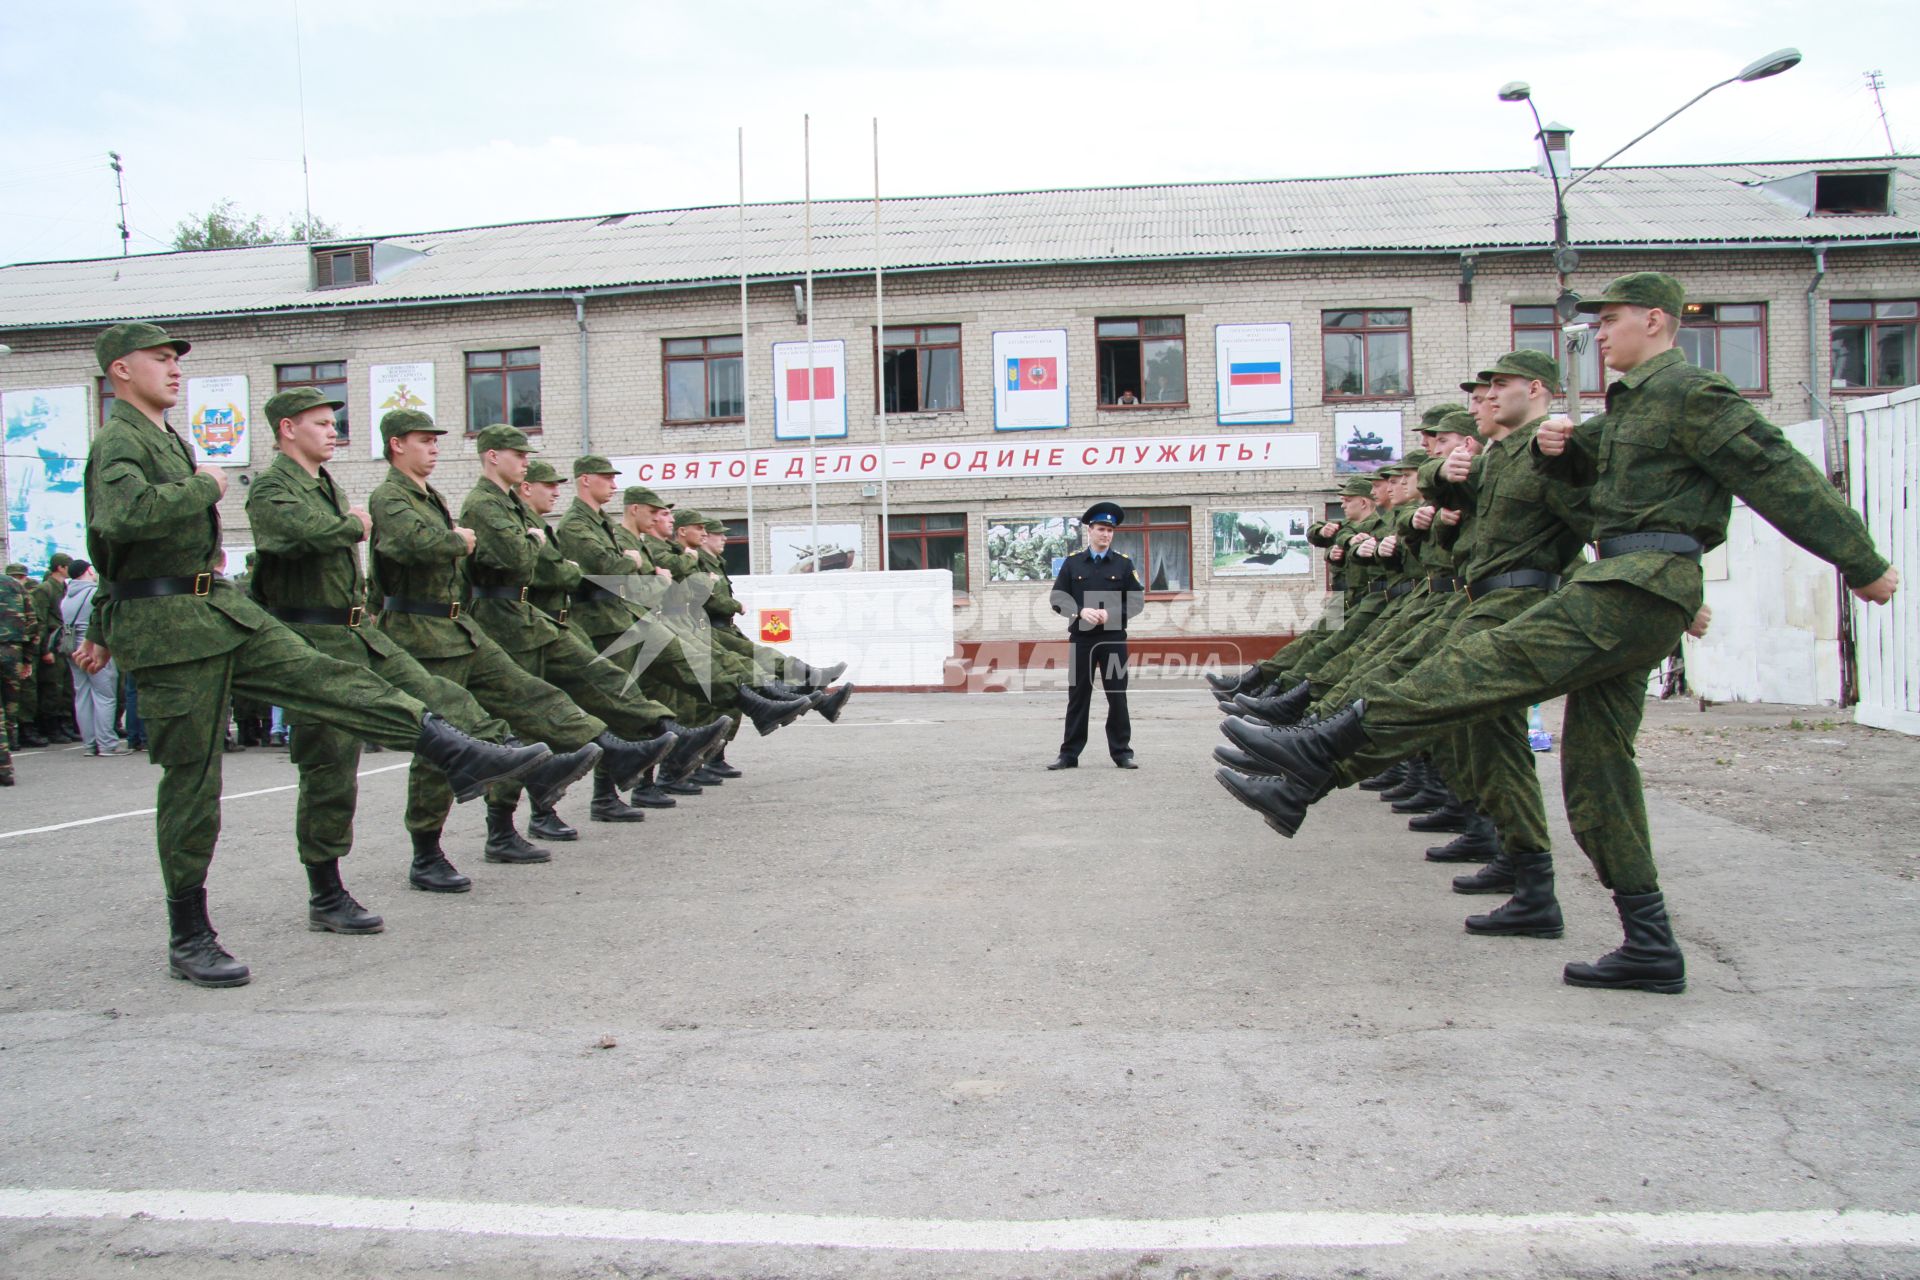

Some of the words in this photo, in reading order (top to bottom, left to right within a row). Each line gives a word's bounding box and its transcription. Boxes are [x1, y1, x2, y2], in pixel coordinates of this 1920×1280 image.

[638, 458, 769, 481] СВЯТОЕ
[785, 454, 878, 479] ДЕЛО
[920, 448, 1064, 472] РОДИНЕ
[1082, 442, 1271, 466] СЛУЖИТЬ!
